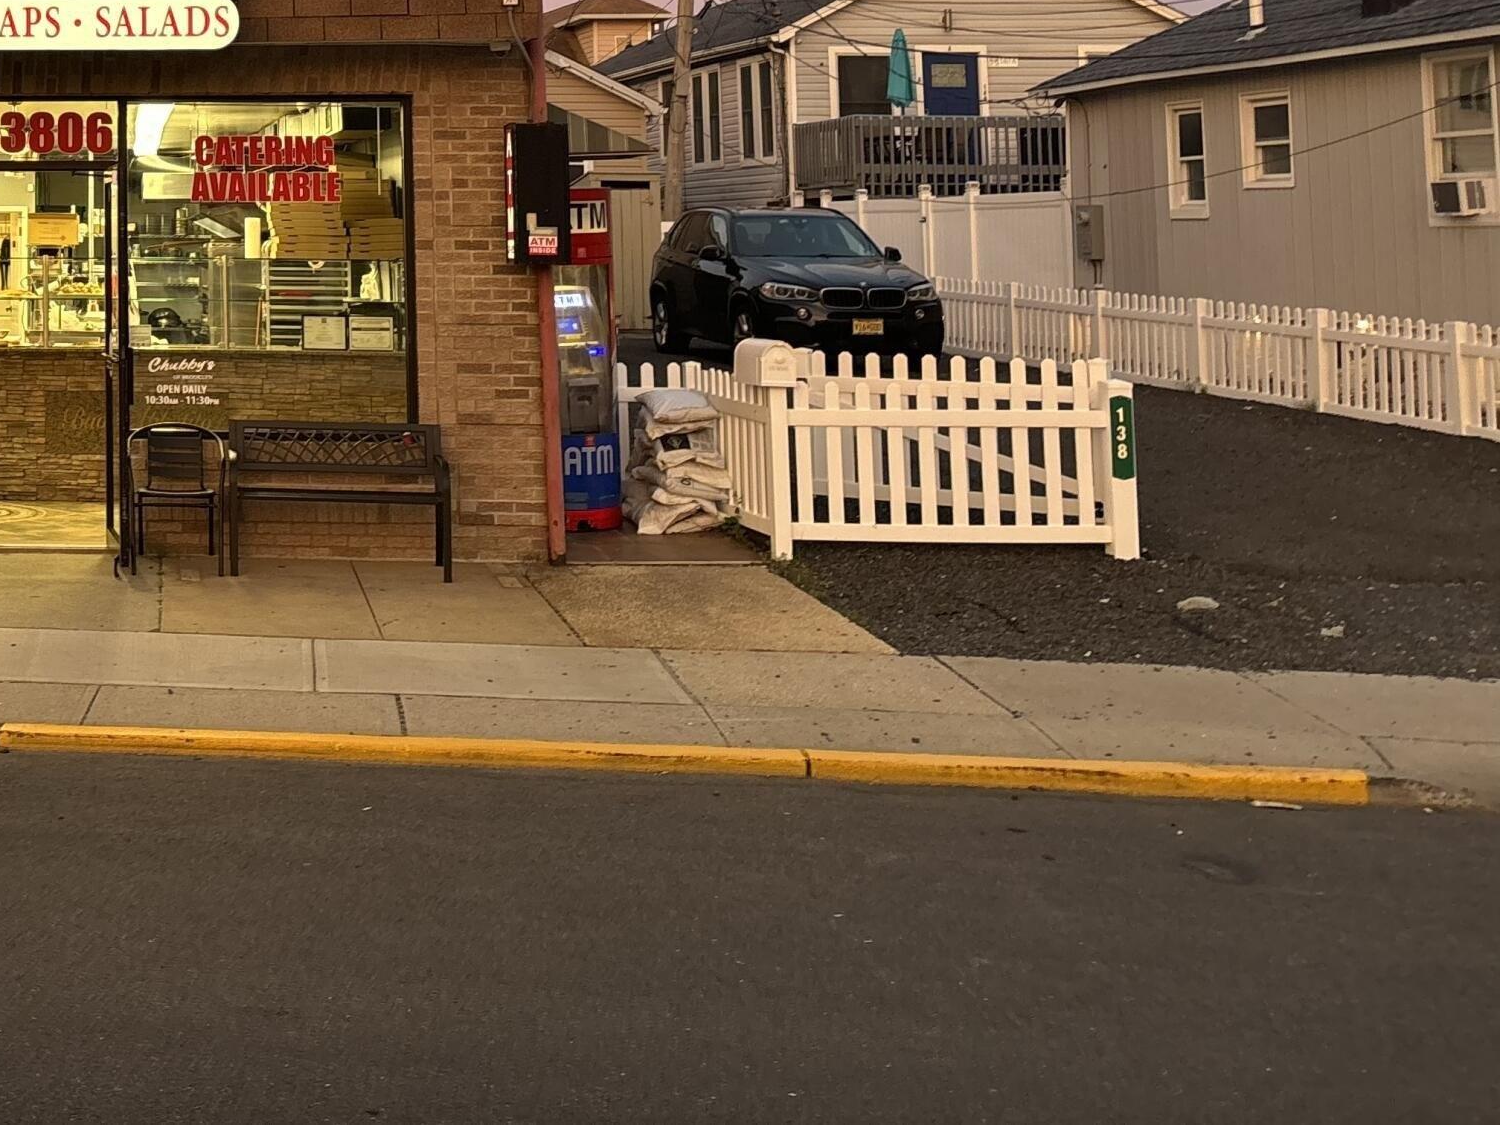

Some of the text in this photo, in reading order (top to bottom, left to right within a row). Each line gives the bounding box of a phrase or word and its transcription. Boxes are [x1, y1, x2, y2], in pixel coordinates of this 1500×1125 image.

[95, 5, 230, 38] SALADS
[194, 135, 335, 167] CATERING
[191, 171, 342, 202] AVAILABLE
[570, 203, 605, 229] TM
[530, 237, 555, 246] ATM
[148, 357, 216, 372] Chubby's
[156, 384, 207, 394] OPEN DAILY
[1116, 406, 1128, 460] 138
[564, 444, 614, 475] ATM
